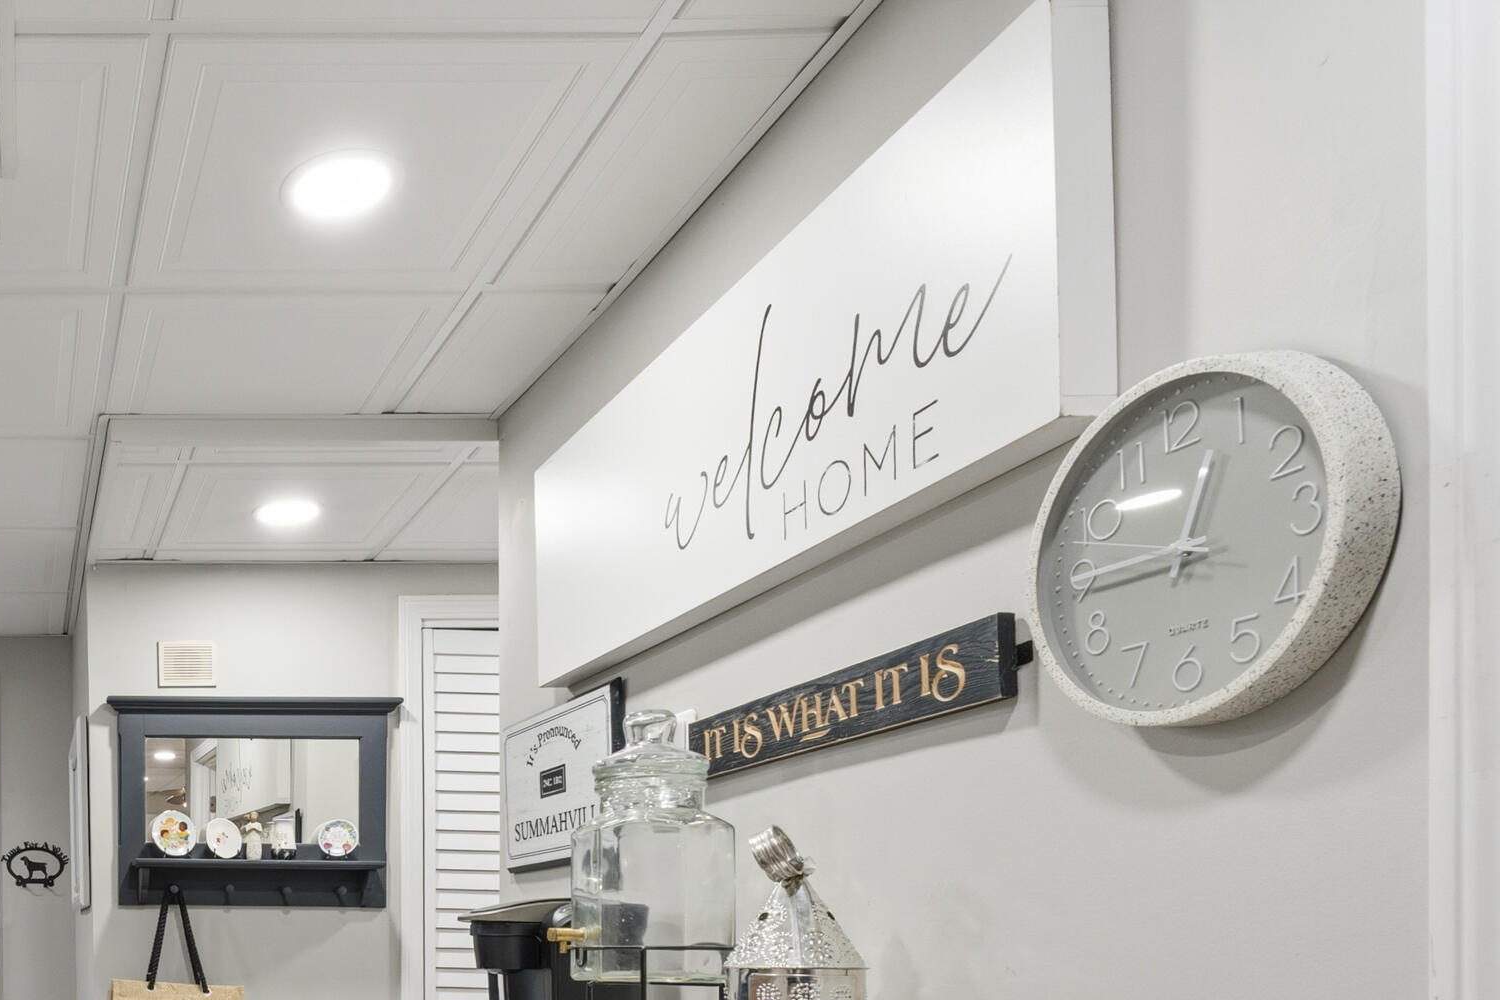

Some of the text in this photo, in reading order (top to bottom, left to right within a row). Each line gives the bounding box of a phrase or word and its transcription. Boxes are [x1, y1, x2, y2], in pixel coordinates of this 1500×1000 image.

[665, 253, 1013, 550] welcome
[1235, 396, 1244, 445] 1
[1161, 400, 1202, 453] 12
[783, 399, 940, 541] HOME
[1116, 440, 1147, 491] 11
[1269, 424, 1306, 481] 2
[1080, 498, 1123, 546] 10
[1289, 480, 1323, 536] 3
[1070, 558, 1097, 603] 9
[1273, 555, 1307, 604] 4
[1085, 610, 1110, 656] 8
[1229, 613, 1261, 663] 5
[1120, 640, 1150, 689] 7
[1172, 644, 1204, 693] 6
[704, 643, 966, 760] IT IS WHAT IT IS
[537, 726, 582, 750] Pronounced
